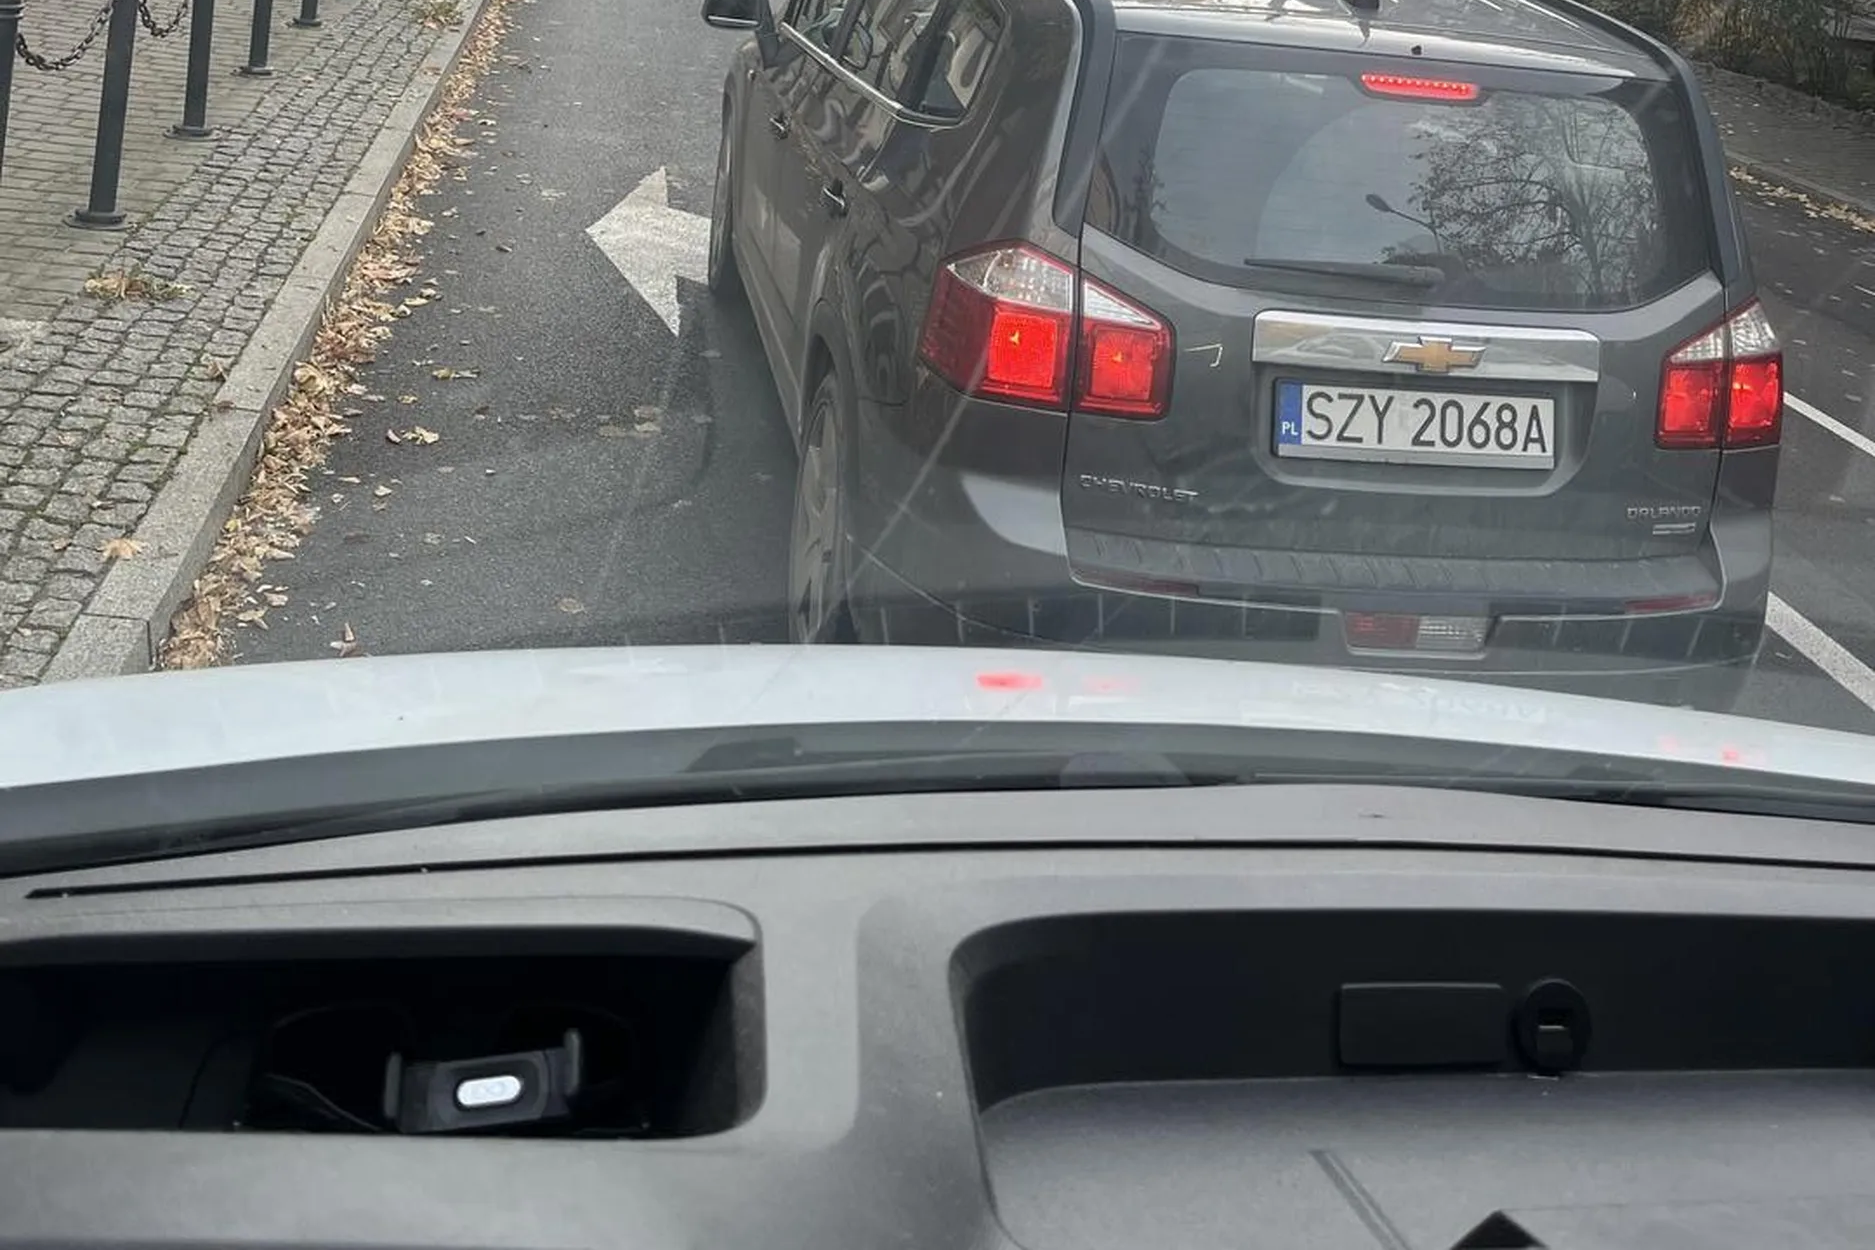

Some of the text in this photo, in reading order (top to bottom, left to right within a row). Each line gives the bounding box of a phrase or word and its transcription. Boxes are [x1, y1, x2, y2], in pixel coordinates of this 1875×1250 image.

[1281, 421, 1299, 436] PL
[1306, 391, 1547, 453] SZY 2068A
